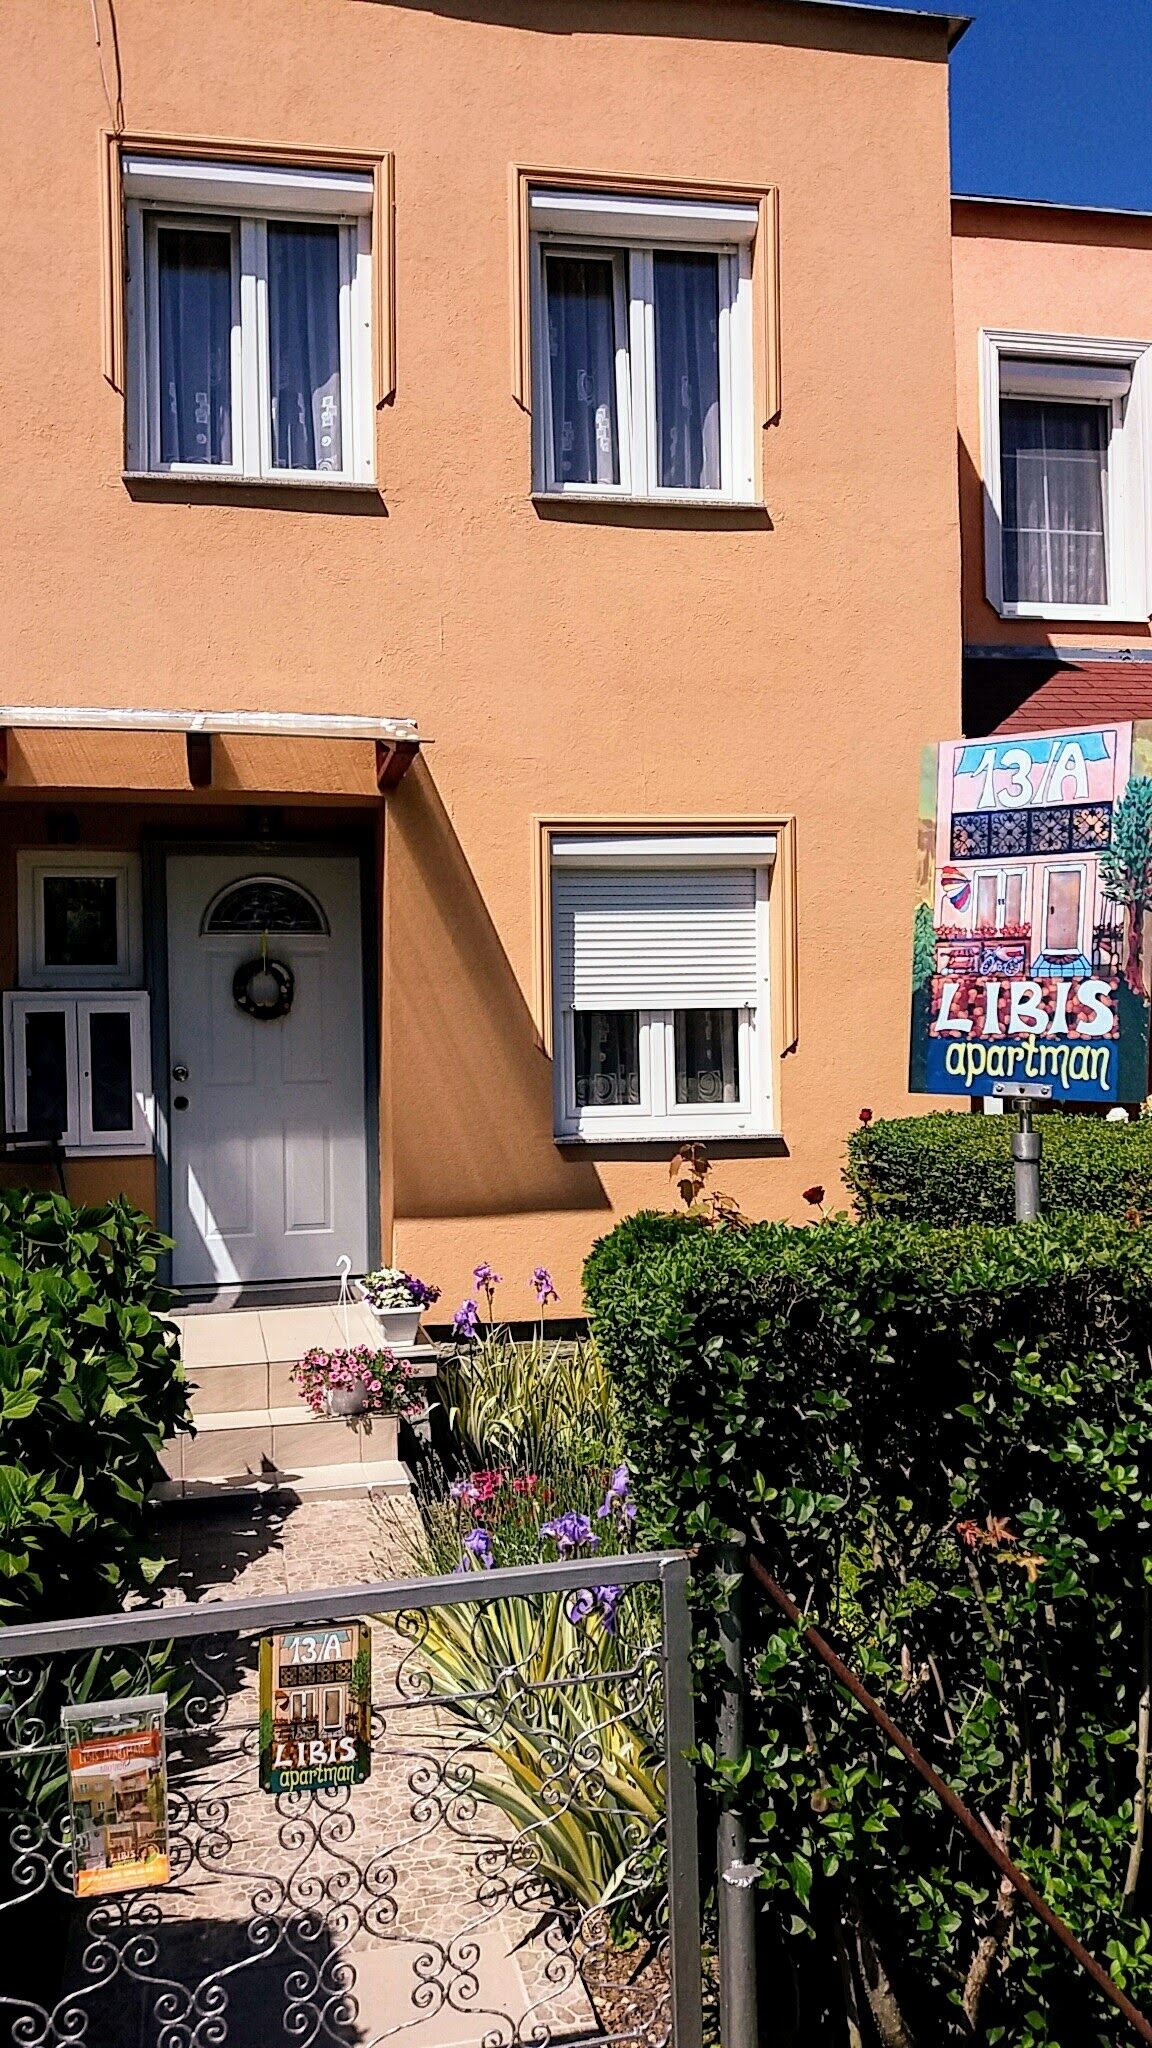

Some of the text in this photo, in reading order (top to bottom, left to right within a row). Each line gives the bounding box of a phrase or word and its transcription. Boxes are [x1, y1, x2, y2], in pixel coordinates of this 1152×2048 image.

[971, 741, 1090, 810] 13/A
[935, 980, 1114, 1036] LIBIS
[945, 1034, 1110, 1090] apartman
[288, 1633, 342, 1664] 13/A
[274, 1737, 357, 1767] LIBIS
[280, 1760, 355, 1791] apartman
